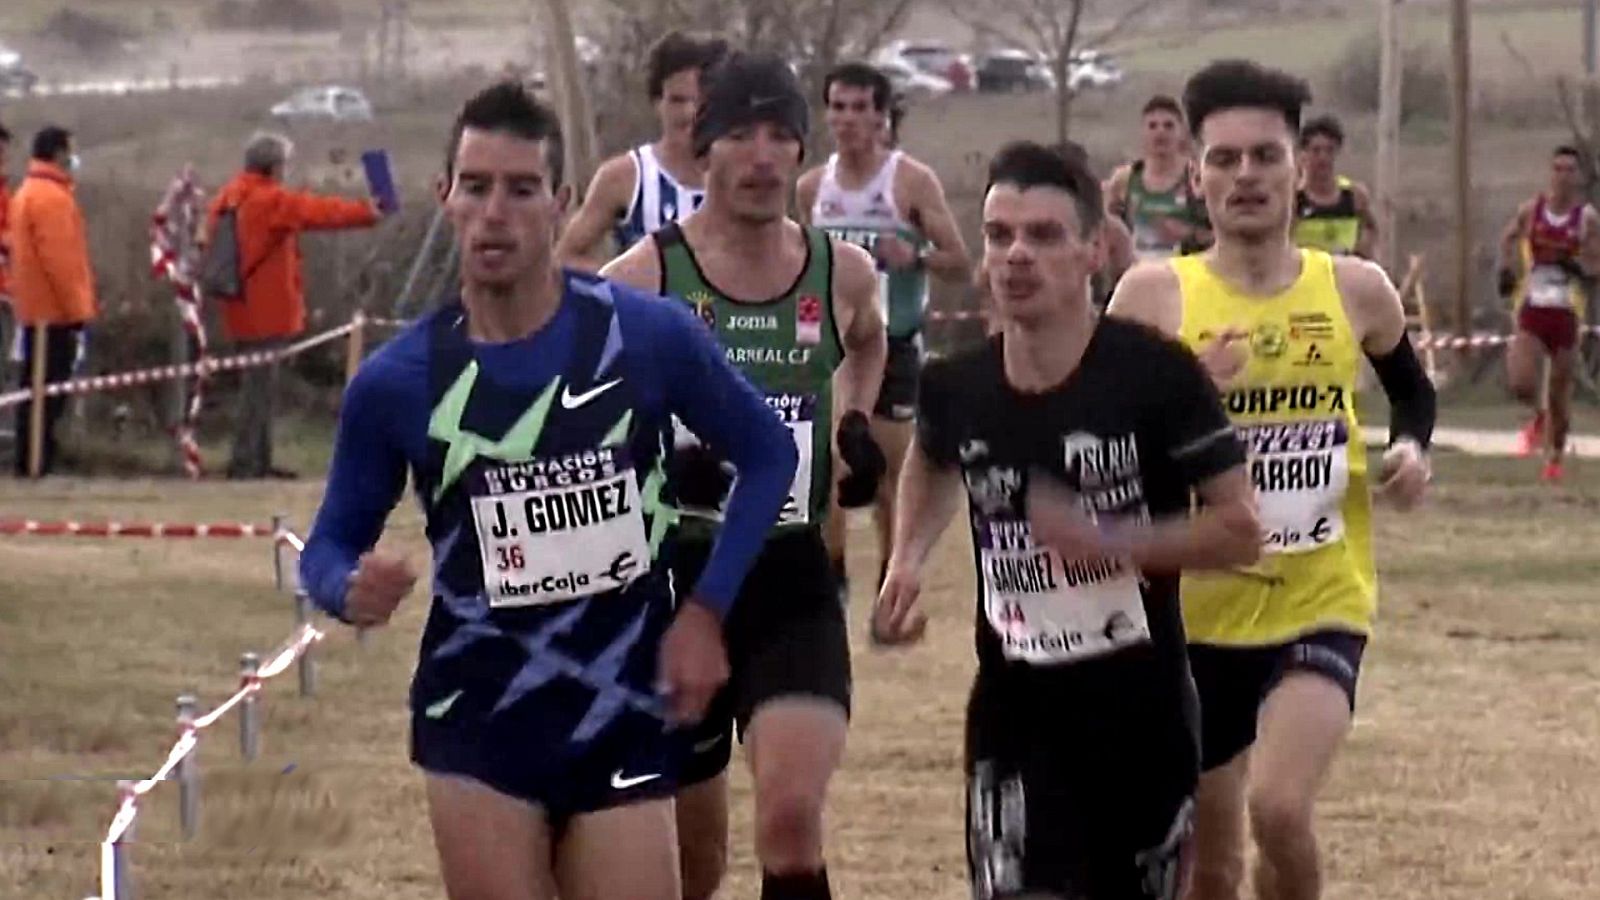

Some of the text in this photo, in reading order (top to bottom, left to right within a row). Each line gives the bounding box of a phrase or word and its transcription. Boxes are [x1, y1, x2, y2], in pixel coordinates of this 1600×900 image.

[491, 479, 632, 538] J. GOMEZ
[496, 545, 525, 571] 36
[992, 551, 1058, 593] SANCHEZ
